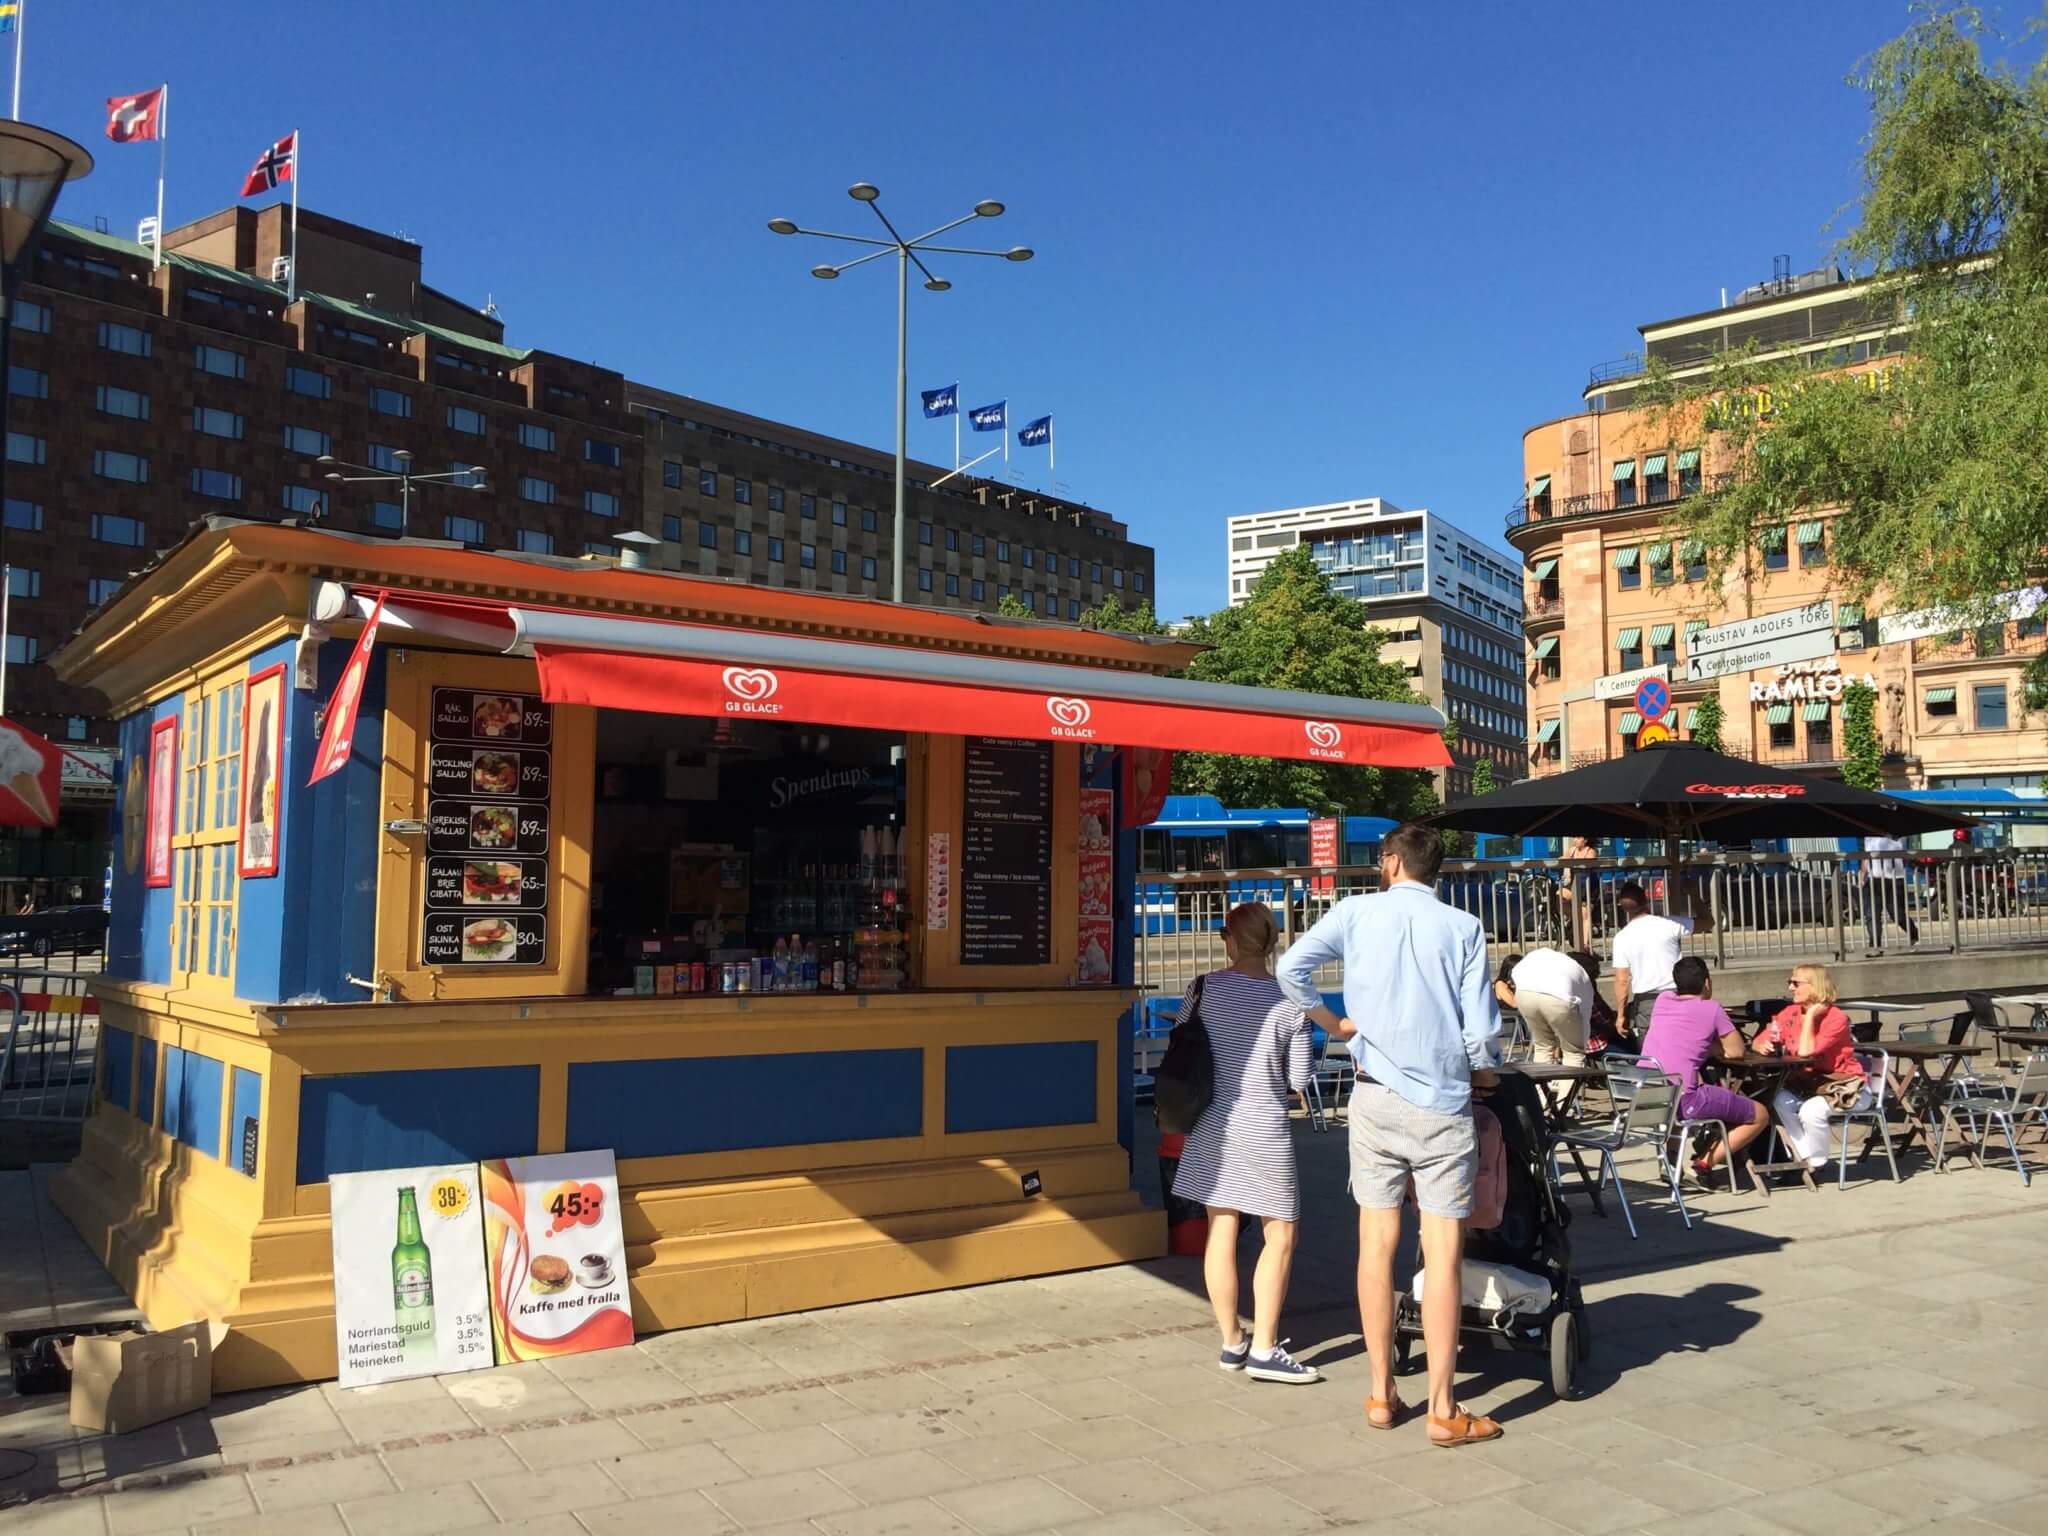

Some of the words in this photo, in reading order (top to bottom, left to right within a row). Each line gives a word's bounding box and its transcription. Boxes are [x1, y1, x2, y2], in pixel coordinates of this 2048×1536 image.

[1705, 627, 1746, 645] GUSTAV
[1752, 617, 1793, 634] ADOLFS
[1800, 608, 1829, 625] TORG
[1706, 650, 1771, 671] Centralstation
[726, 702, 740, 711] GB
[437, 713, 468, 724] SALLAD
[1051, 726, 1063, 736] GB
[432, 758, 472, 769] KYCKLING
[436, 769, 467, 779] SALLAD
[770, 766, 870, 808] Spendrups
[1685, 783, 1806, 795] Coca-Cola
[431, 815, 468, 826] GREKISK
[433, 825, 466, 836] SALLAD
[431, 867, 462, 878] SALAMI
[437, 878, 457, 888] BRIE
[429, 888, 462, 899] CIBATTA
[435, 924, 454, 934] OST
[428, 935, 460, 945] SKINKA
[428, 946, 459, 956] FRALLA
[438, 1186, 465, 1208] 39:-
[550, 1192, 599, 1218] 45:-
[519, 1301, 554, 1315] Kaffe
[558, 1296, 584, 1309] med
[587, 1292, 620, 1305] fralla
[348, 1320, 430, 1339] Norrlandsguld
[456, 1313, 482, 1325] 3.5%
[348, 1338, 406, 1354] Mariestad
[457, 1328, 484, 1340] 3.5%
[349, 1354, 404, 1369] Heineken
[458, 1342, 485, 1354] 3.5%
